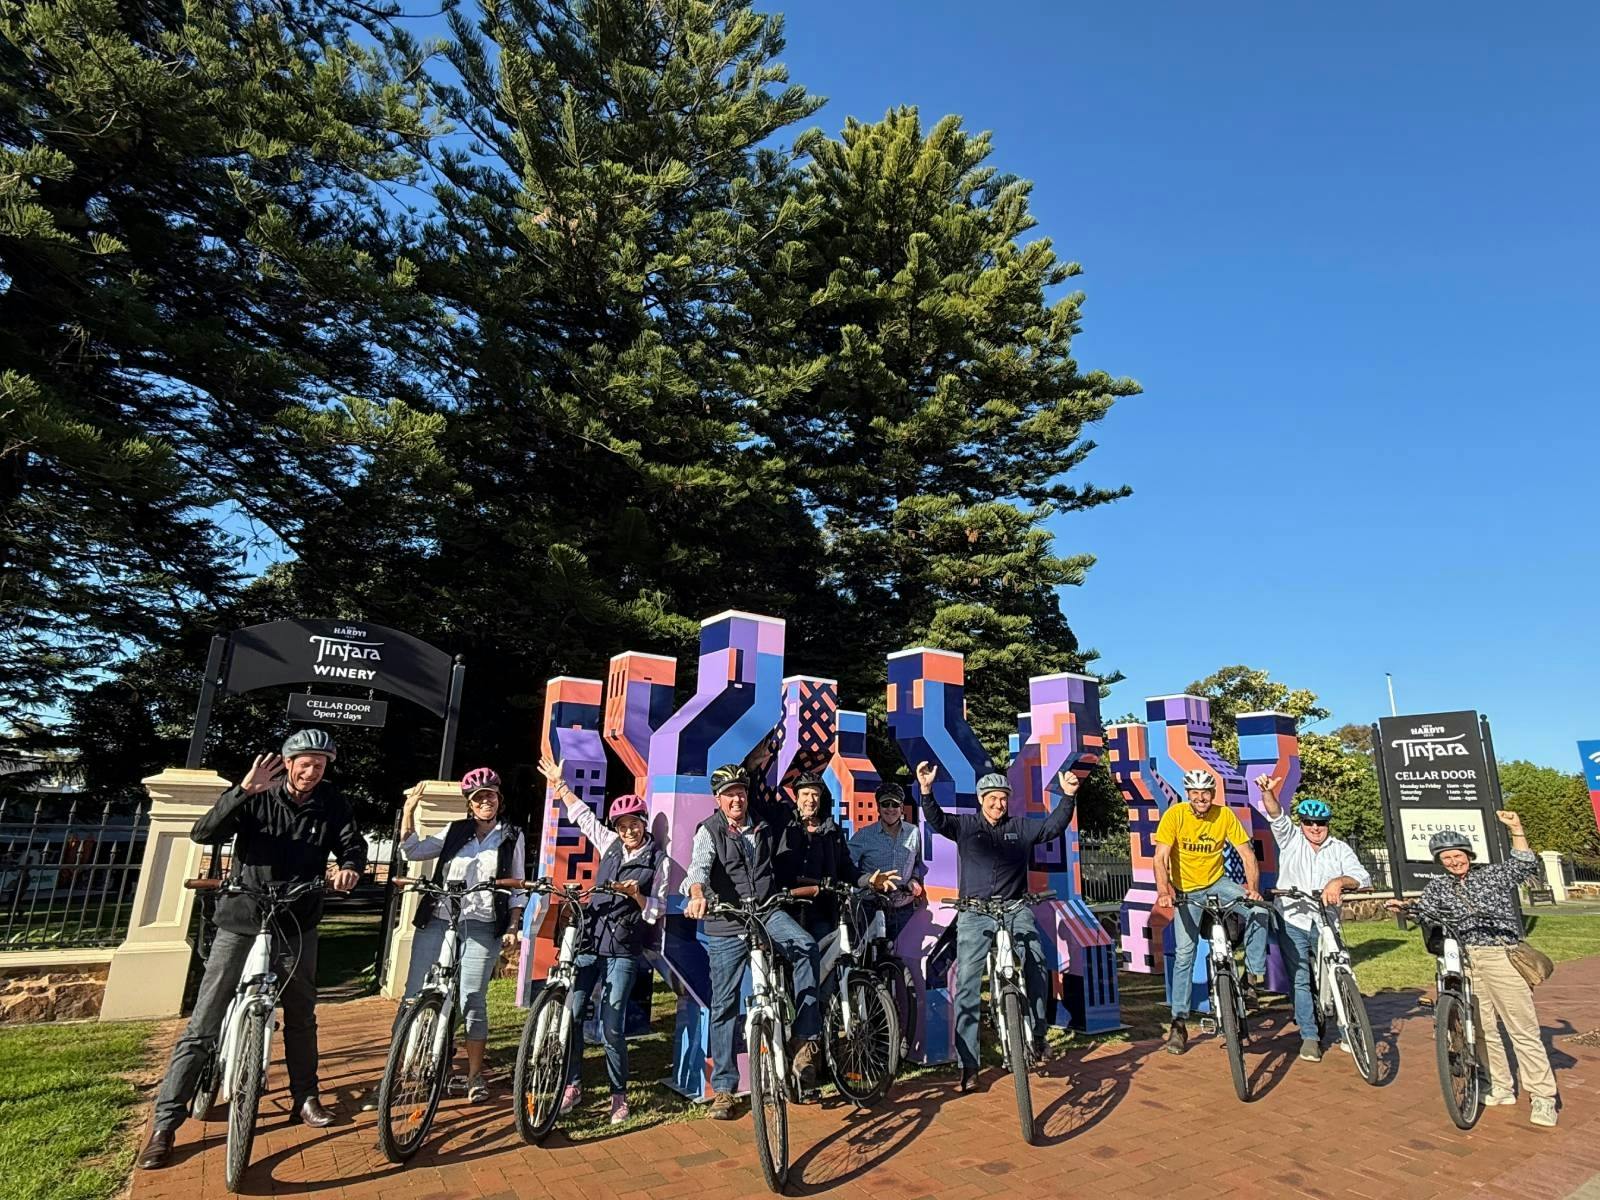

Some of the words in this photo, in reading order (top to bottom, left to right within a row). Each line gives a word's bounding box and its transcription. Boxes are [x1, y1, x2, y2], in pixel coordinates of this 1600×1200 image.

[309, 635, 385, 663] Tintara
[313, 664, 377, 681] WINERY
[306, 700, 343, 710] CELLAR
[344, 703, 371, 713] DOOR
[313, 709, 336, 719] Open
[343, 711, 362, 721] days
[1391, 733, 1470, 767] Tintara
[1394, 770, 1440, 780] CELLAR
[1440, 769, 1477, 780] DOOR
[1411, 824, 1476, 832] FLEURIEU
